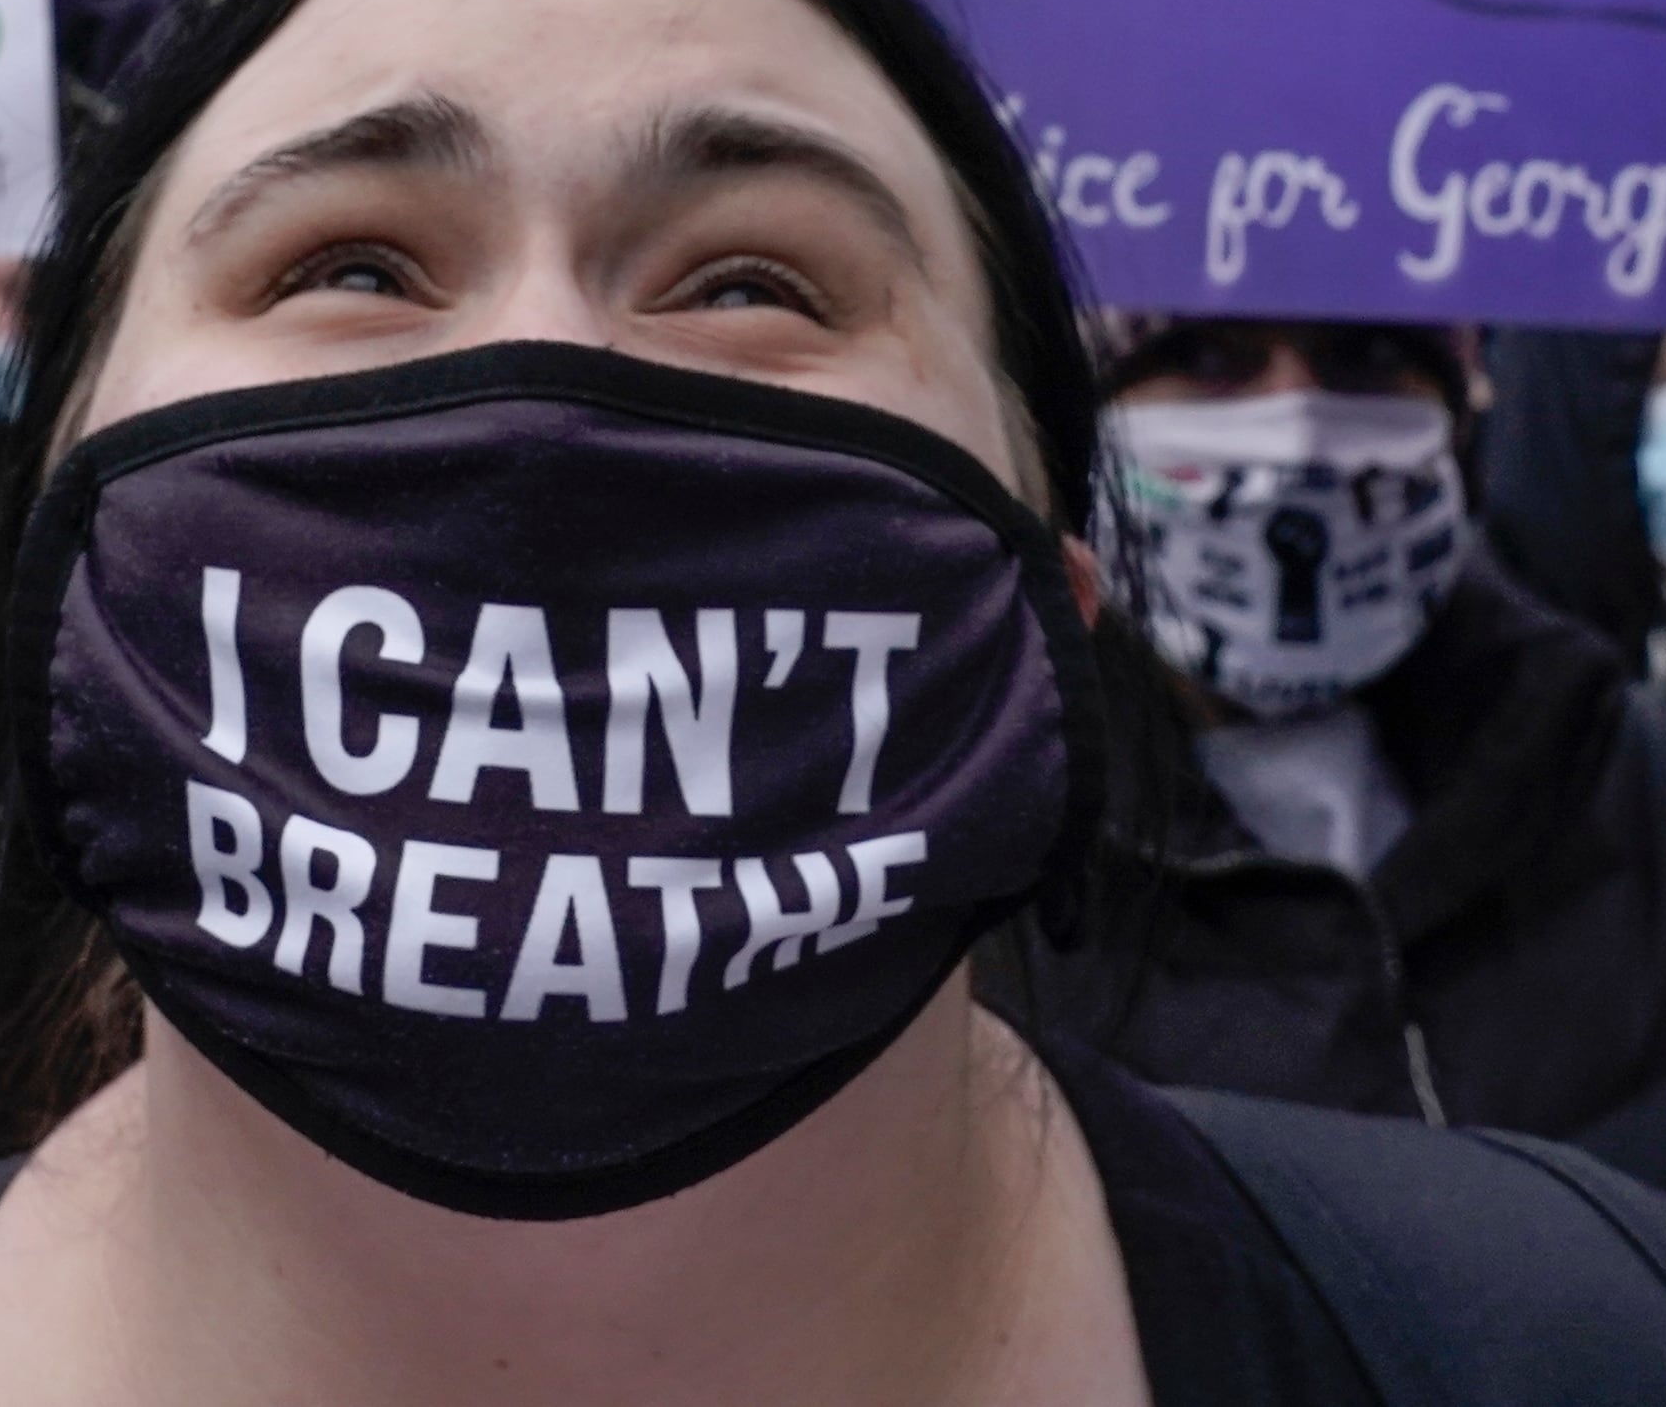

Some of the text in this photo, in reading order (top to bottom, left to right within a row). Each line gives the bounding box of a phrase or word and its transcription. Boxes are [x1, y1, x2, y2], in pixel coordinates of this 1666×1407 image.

[997, 96, 1173, 229] ice
[1205, 146, 1359, 285] for
[200, 565, 922, 818] I CAN'T
[185, 778, 928, 1023] BREATHE
